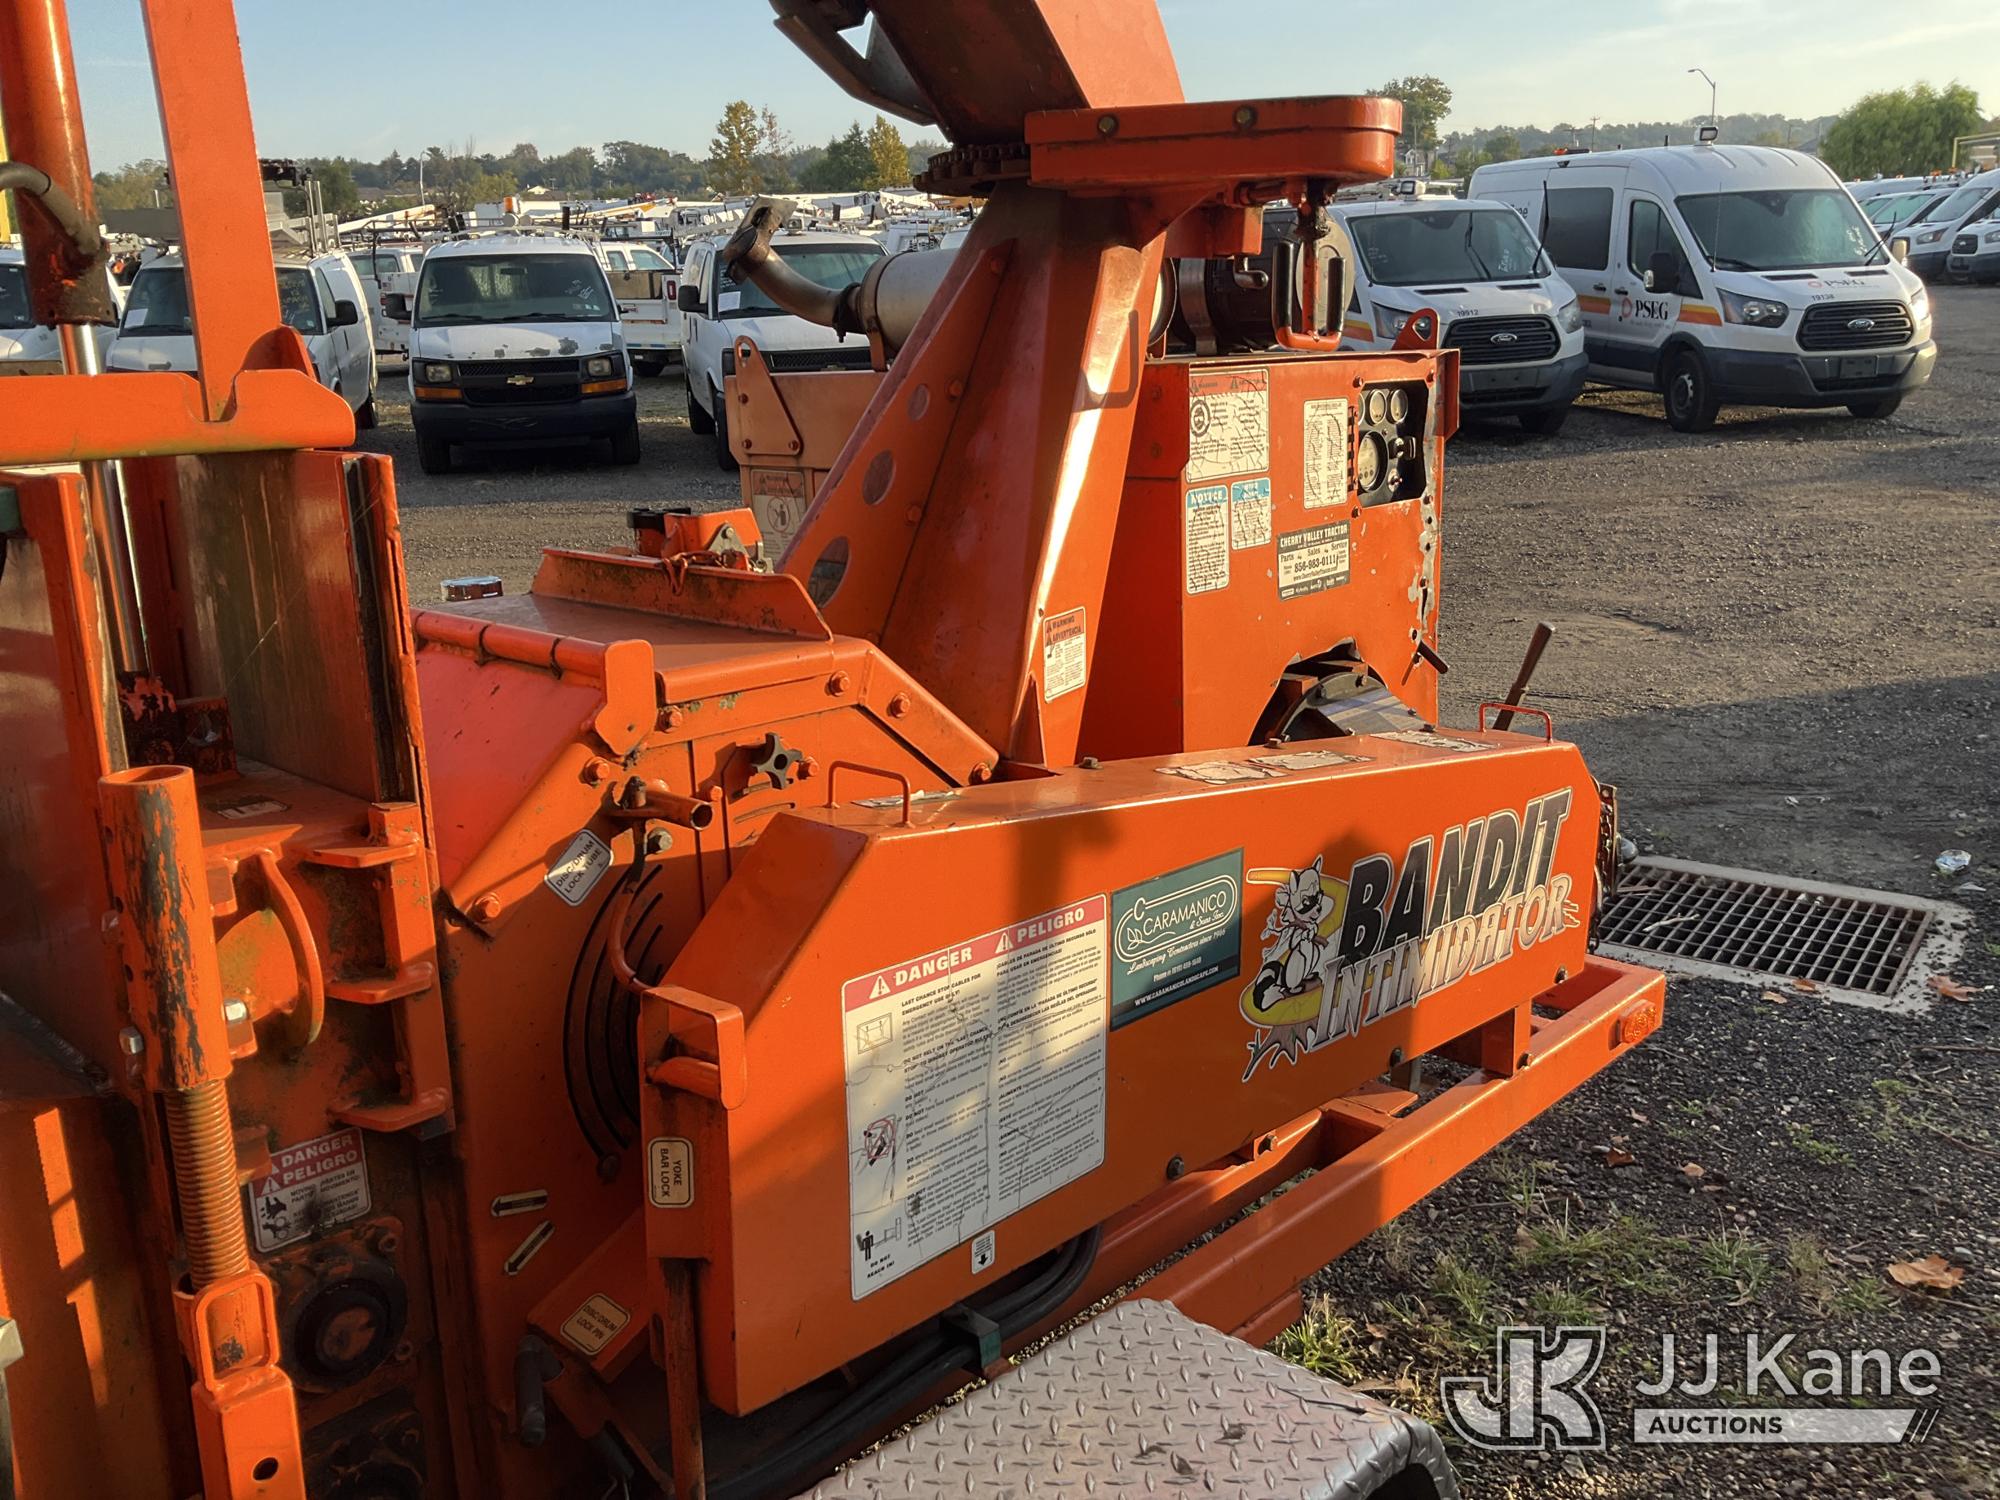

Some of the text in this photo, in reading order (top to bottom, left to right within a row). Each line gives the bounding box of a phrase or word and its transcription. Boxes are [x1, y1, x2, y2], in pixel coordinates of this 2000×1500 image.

[1635, 299, 1668, 320] PSEG
[1280, 534, 1302, 548] CHERRY
[1303, 530, 1324, 541] VALLEY
[1324, 524, 1348, 538] TRACTOR
[1280, 554, 1295, 562] Parts
[1307, 547, 1321, 556] Sales
[555, 840, 595, 888] DISC/DRUM
[564, 849, 602, 894] LOCK TUBE
[1337, 787, 1573, 962] BANDIT
[1017, 907, 1085, 943] PELIGRO
[1143, 891, 1226, 936] CARAMANICO
[895, 947, 973, 987] DANGER
[1307, 875, 1573, 1050] INTIMIDATOR
[901, 998, 914, 1007] LAST
[915, 989, 936, 1002] CHANCE
[951, 977, 970, 988] CABLES
[971, 973, 980, 981] FOR
[901, 1000, 932, 1016] EMERGENCY
[281, 1135, 353, 1168] DANGER
[282, 1150, 358, 1185] PELIGRO
[660, 1148, 670, 1198] BAR LOCK
[672, 1160, 682, 1186] YOKE
[577, 1317, 594, 1332] LOCK
